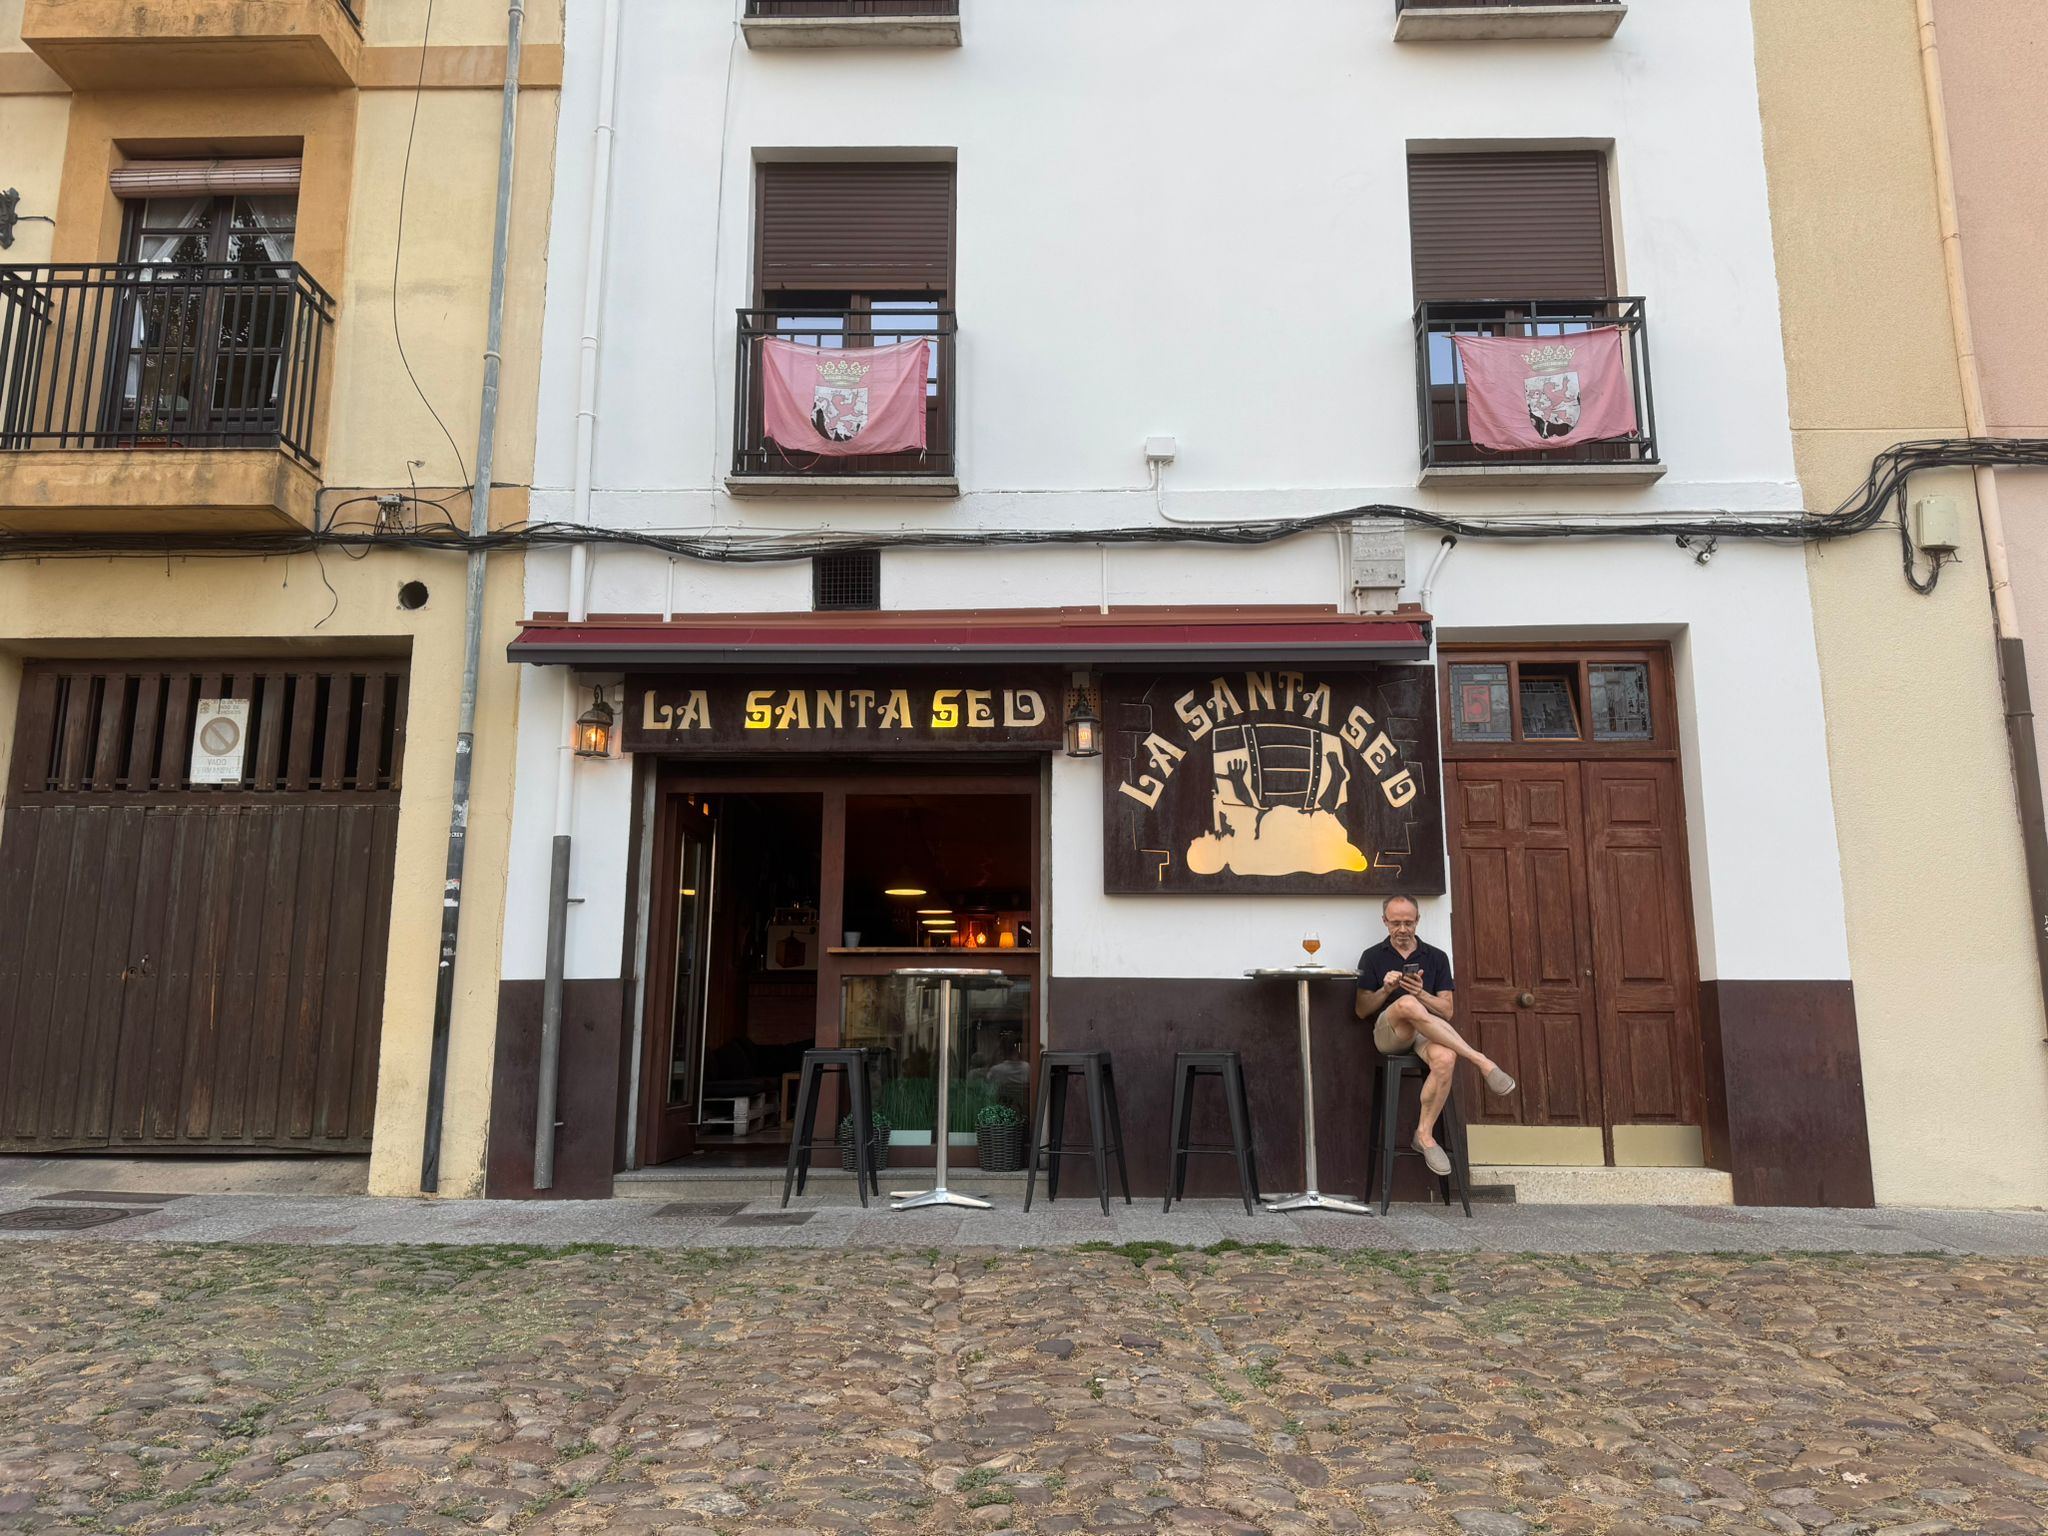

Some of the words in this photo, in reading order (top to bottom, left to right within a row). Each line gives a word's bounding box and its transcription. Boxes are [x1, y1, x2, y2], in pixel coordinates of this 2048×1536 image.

[642, 690, 711, 730] LA
[744, 688, 914, 730] SANTA
[931, 688, 1046, 729] SED
[1118, 732, 1187, 811] LA
[1174, 671, 1332, 742] SANTA
[1339, 705, 1418, 809] SED
